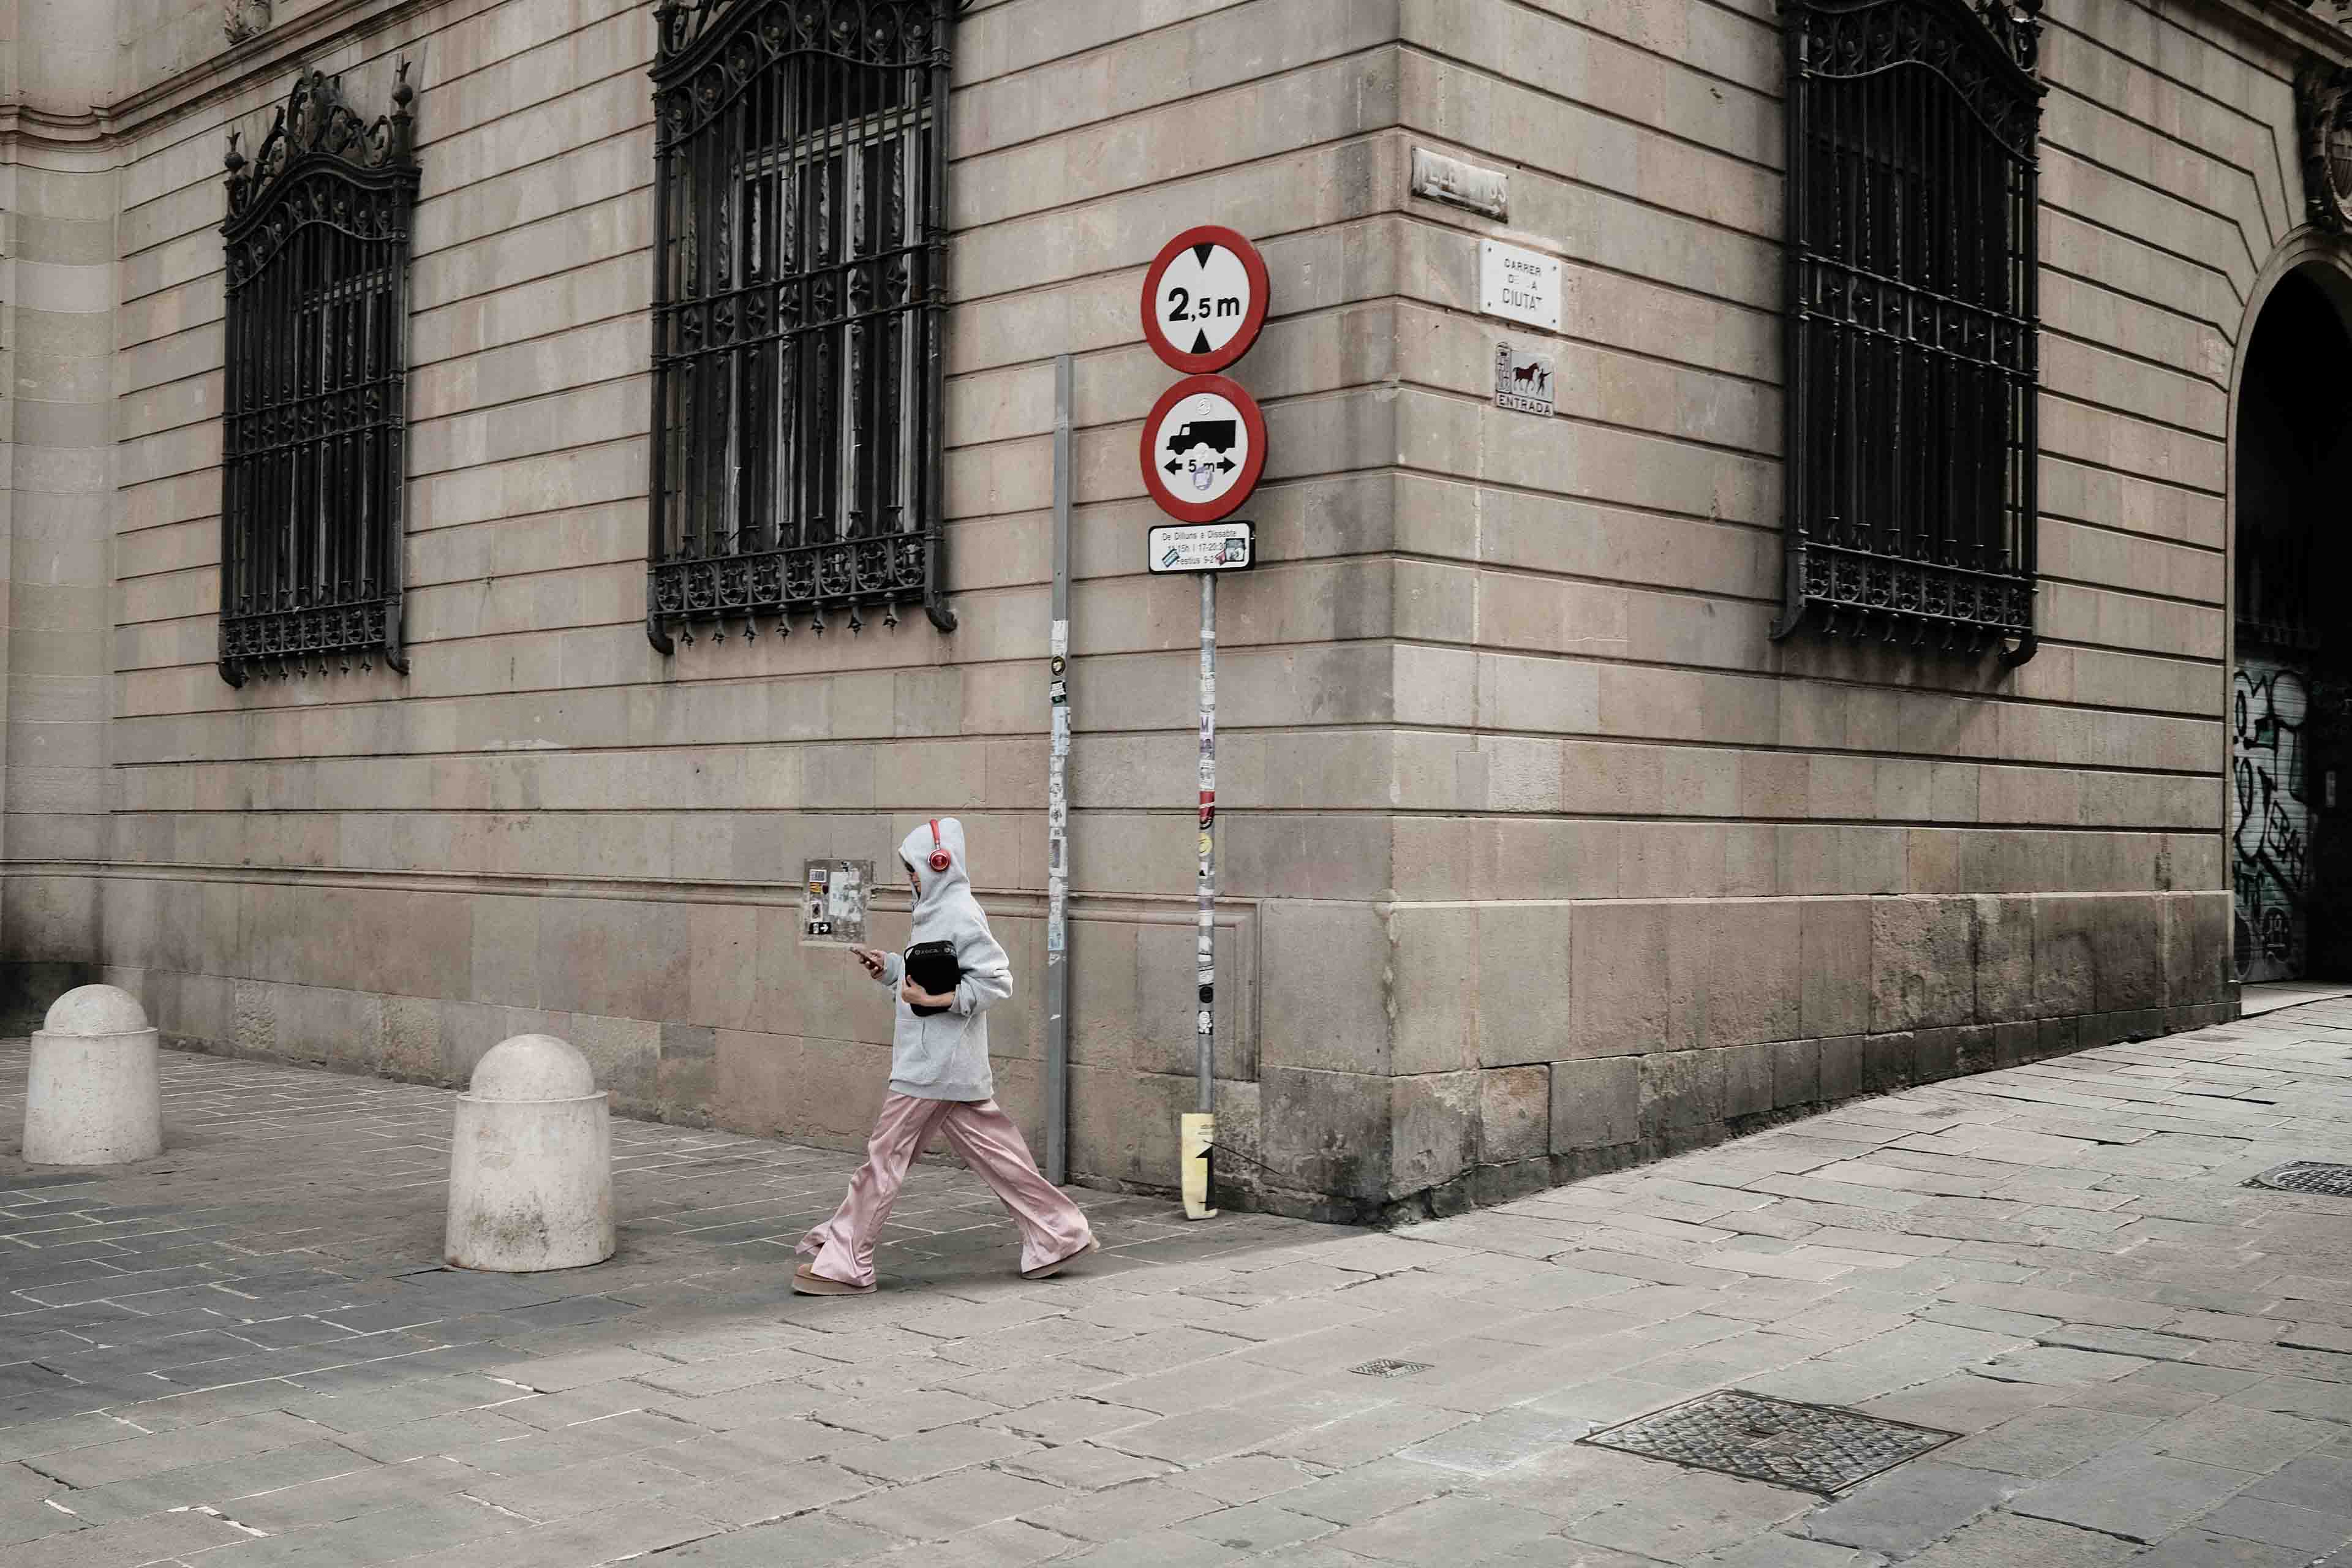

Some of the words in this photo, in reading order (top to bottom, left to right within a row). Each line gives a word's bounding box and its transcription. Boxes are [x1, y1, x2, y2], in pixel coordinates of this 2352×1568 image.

[1504, 258, 1542, 277] CARRER
[1168, 287, 1211, 322] 2,5
[1216, 296, 1240, 317] m
[1499, 394, 1551, 416] ENTRADA
